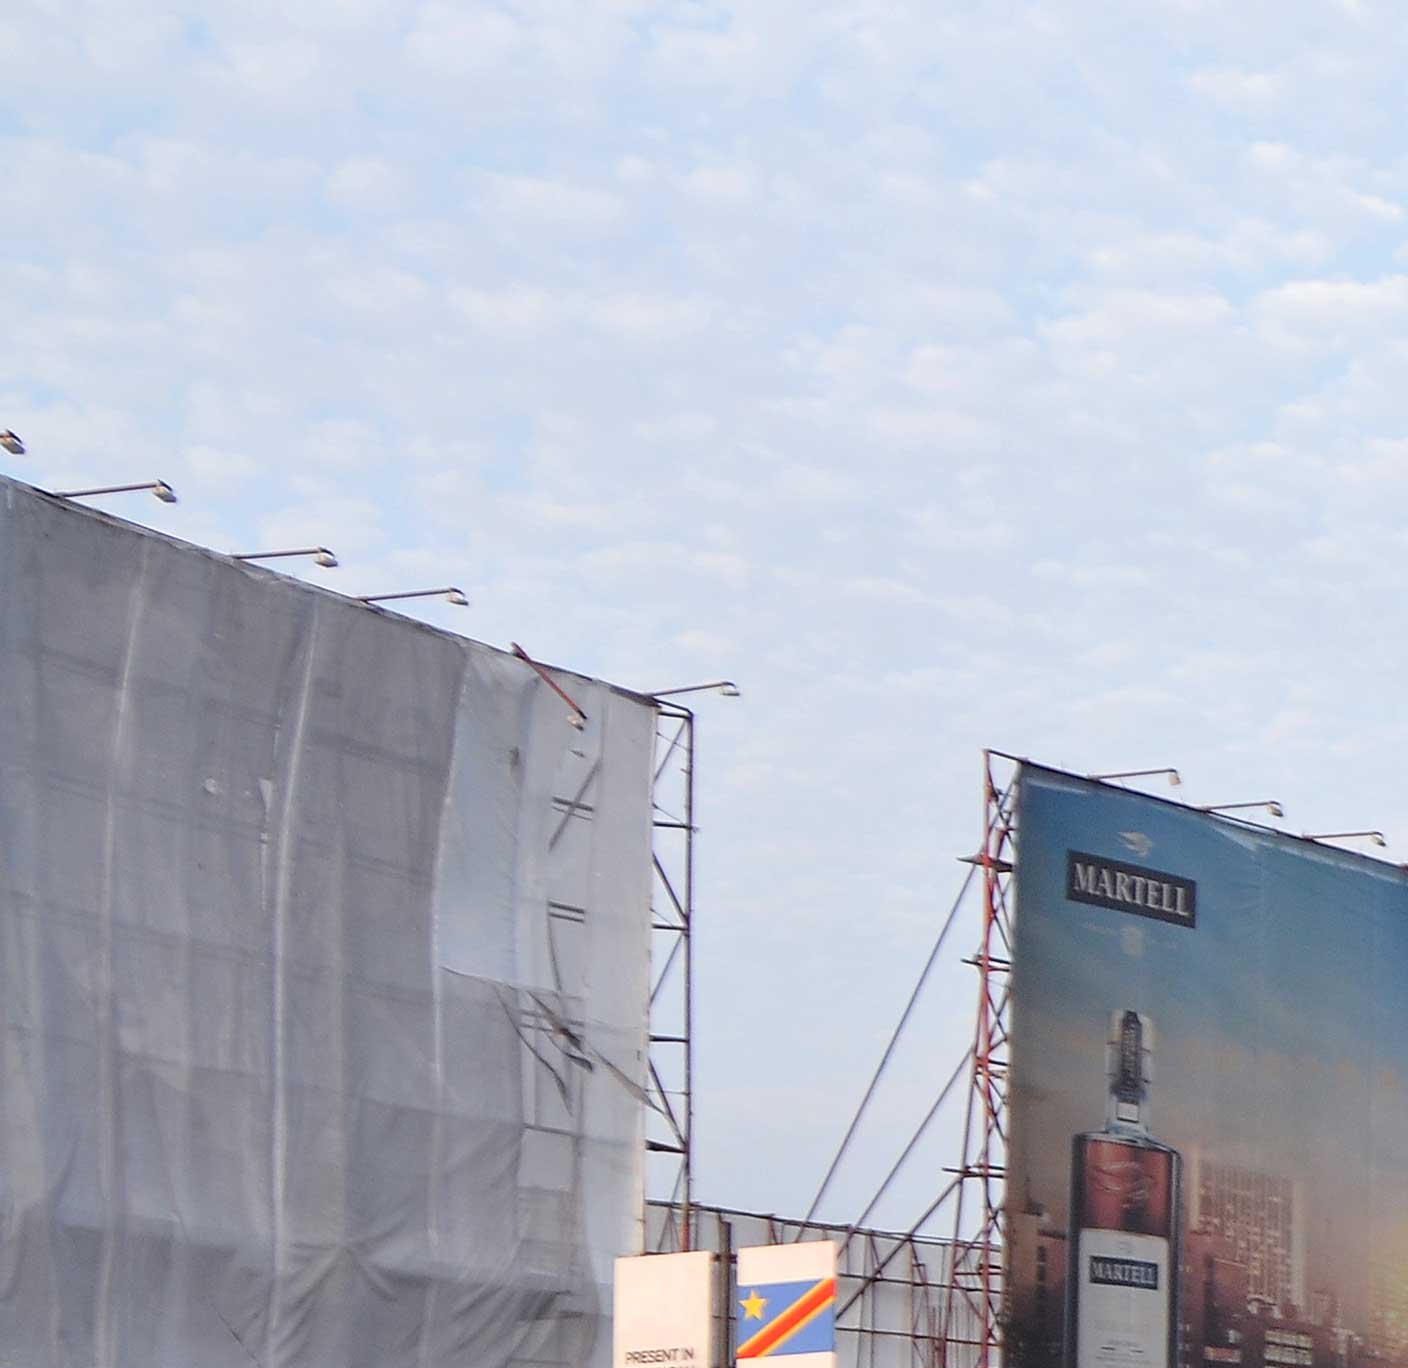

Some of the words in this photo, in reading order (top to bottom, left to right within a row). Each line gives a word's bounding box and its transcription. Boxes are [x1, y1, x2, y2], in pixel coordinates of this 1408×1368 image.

[1073, 862, 1189, 916] MARTELL
[1091, 1261, 1156, 1285] MARTELL
[625, 1349, 679, 1364] PRESENT
[681, 1348, 694, 1360] IN
